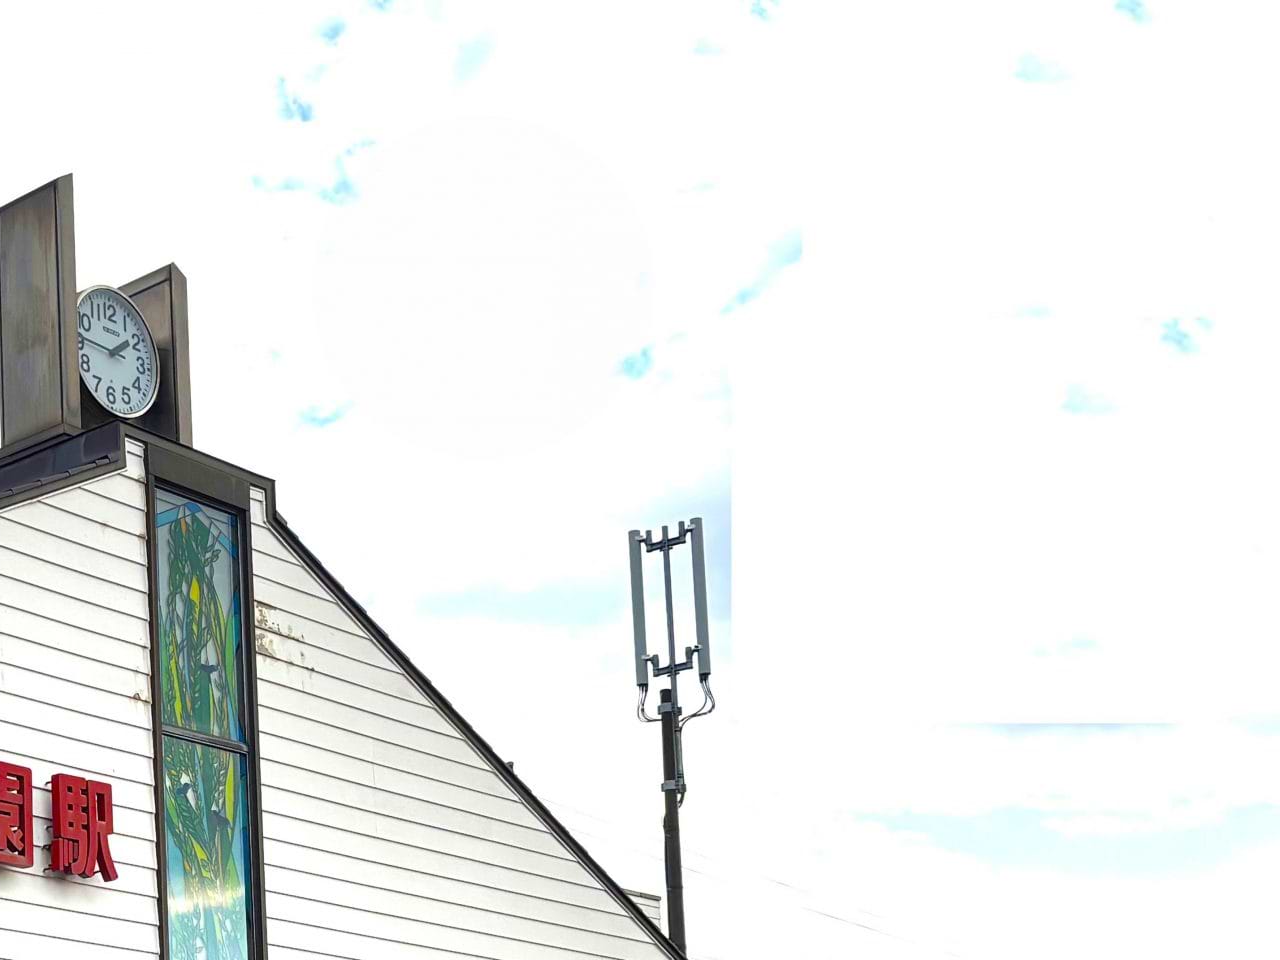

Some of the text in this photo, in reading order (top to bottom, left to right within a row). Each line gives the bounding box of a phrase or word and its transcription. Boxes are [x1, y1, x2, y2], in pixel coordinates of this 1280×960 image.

[103, 301, 117, 324] 12
[131, 333, 141, 352] 2
[81, 353, 90, 373] 8
[136, 356, 146, 375] 3
[92, 374, 102, 393] 7
[131, 376, 141, 394] 4
[106, 385, 116, 405] 6
[121, 385, 131, 405] 5
